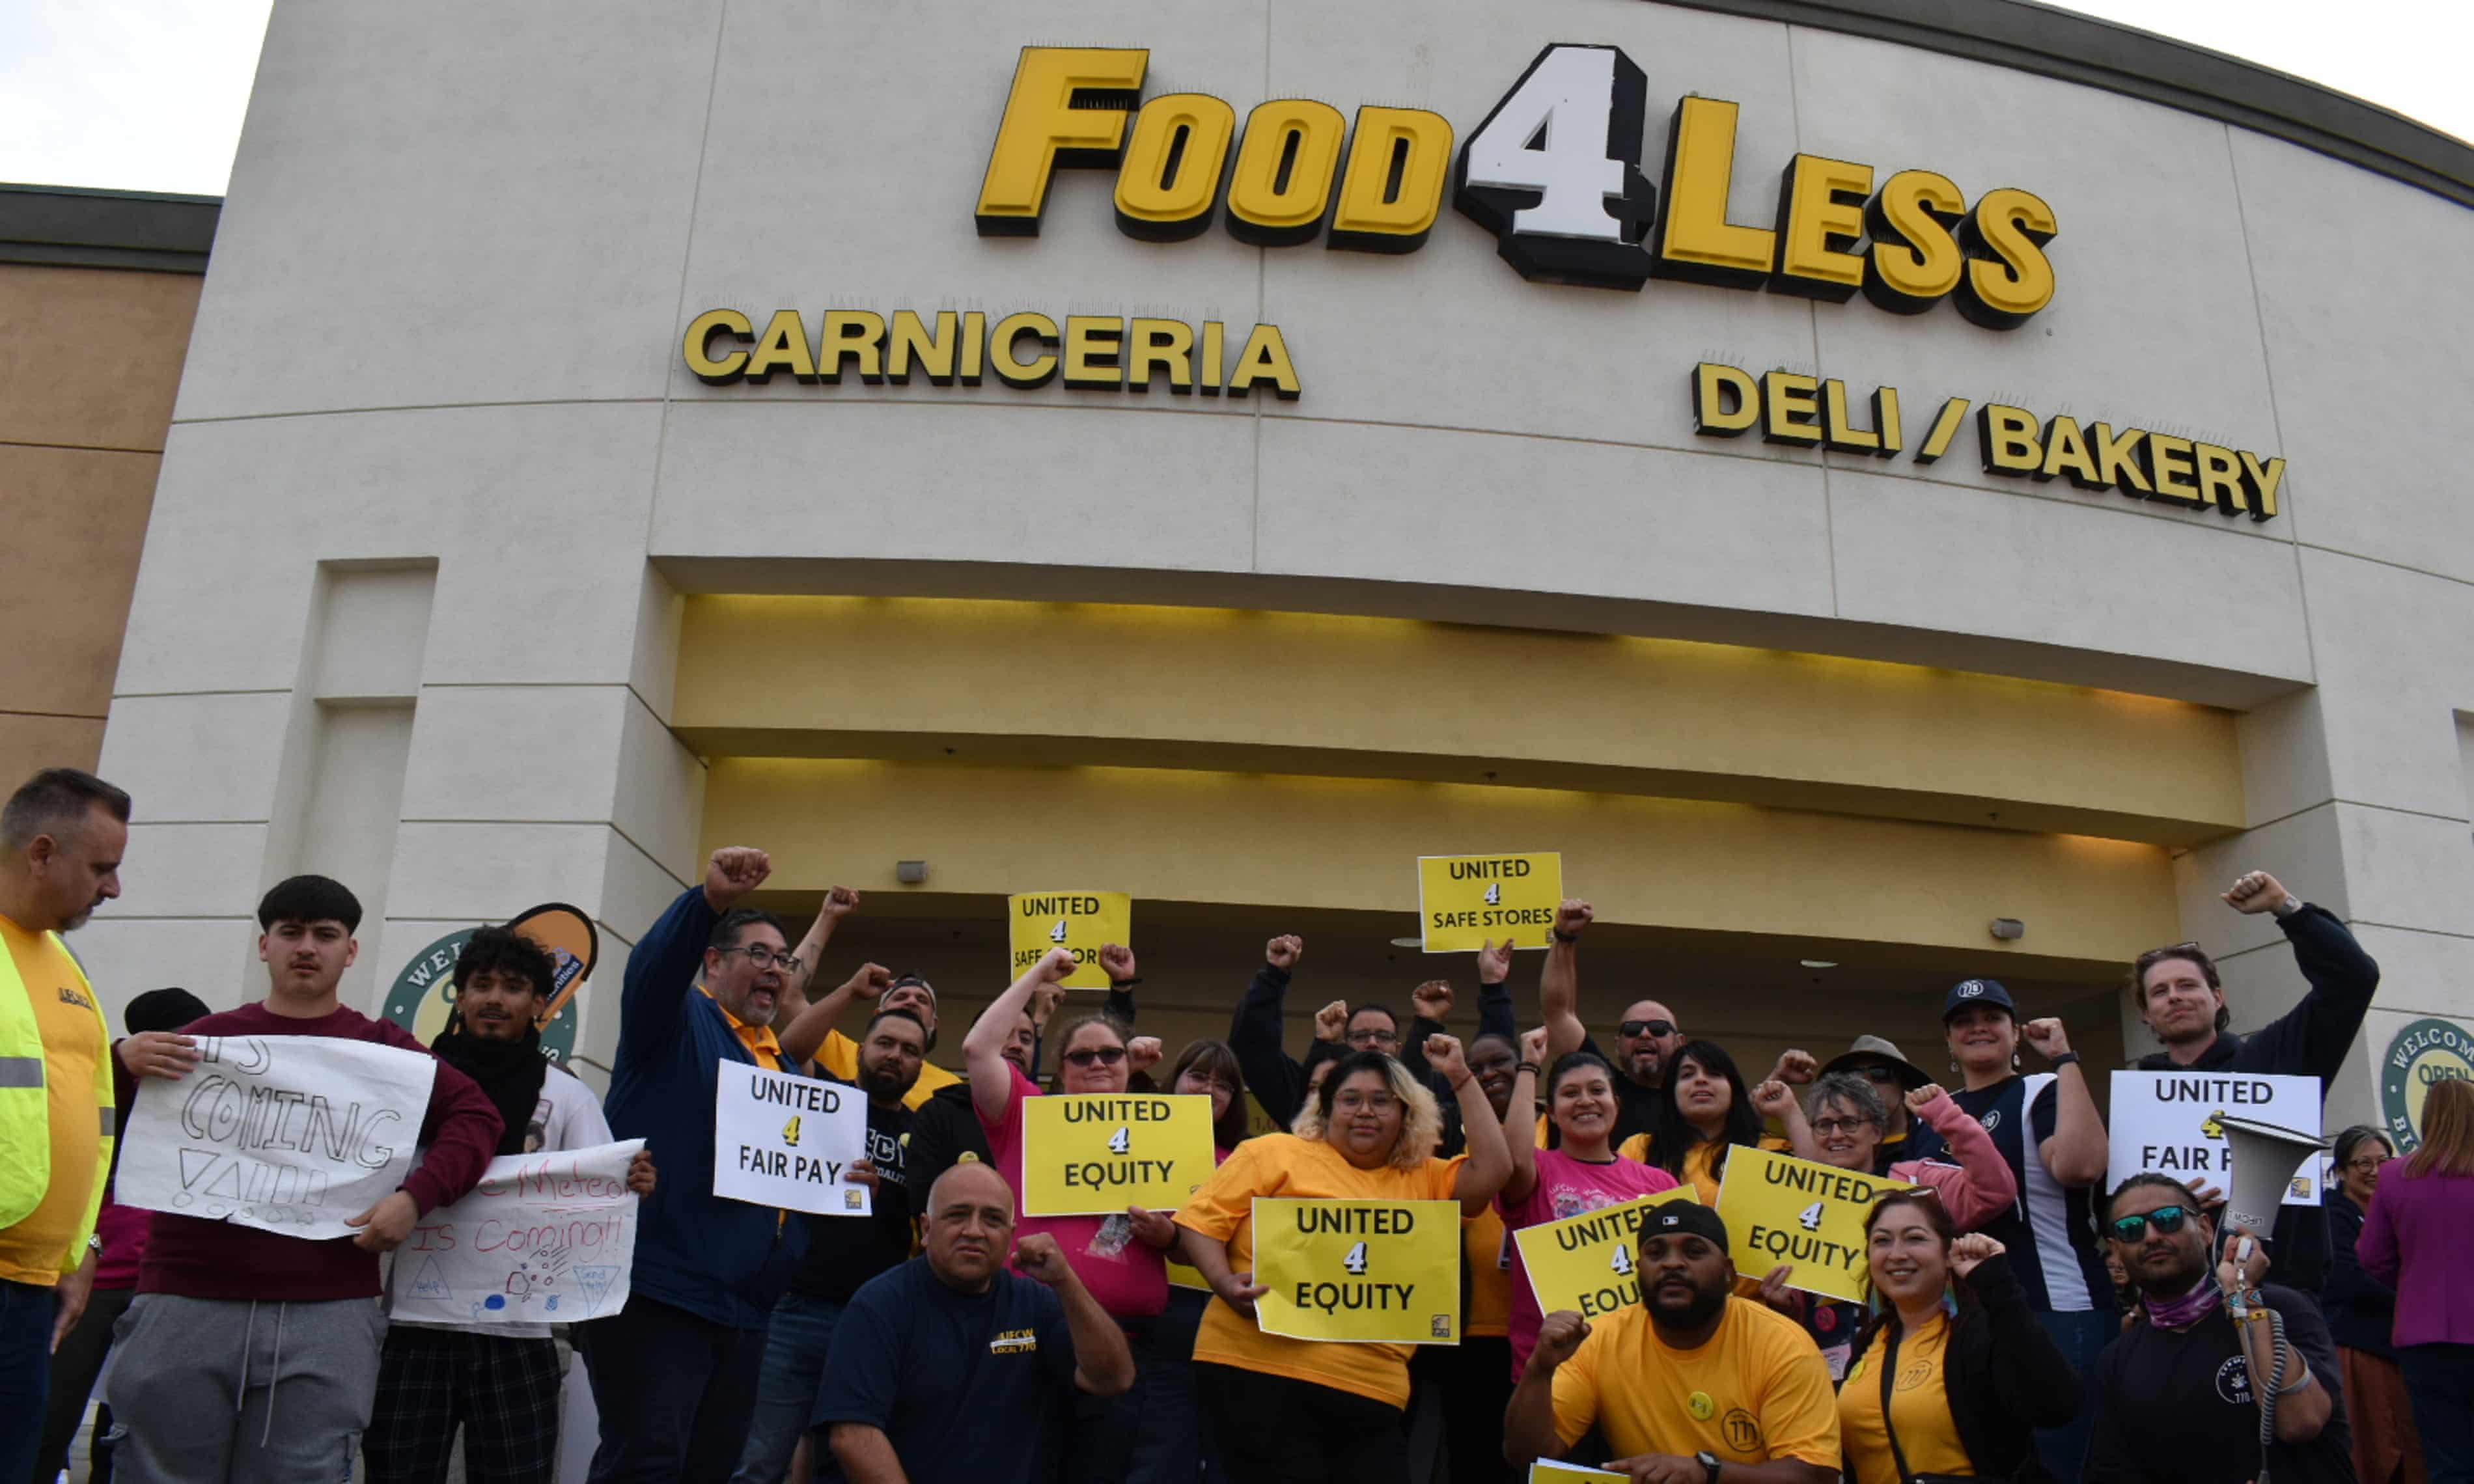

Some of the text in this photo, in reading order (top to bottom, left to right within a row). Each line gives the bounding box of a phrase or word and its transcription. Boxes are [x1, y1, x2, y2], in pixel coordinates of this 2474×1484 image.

[975, 42, 2059, 329] FOOD 4 LESS
[682, 308, 1301, 400] CARNICERIA
[1693, 362, 1903, 458] DELI
[1977, 404, 2286, 521] BAKERY
[1449, 859, 1531, 879] UNITED
[1022, 897, 1100, 917] UNITED
[1484, 883, 1501, 906] 4
[1049, 920, 1067, 943] 4
[1434, 908, 1553, 929] SAFE STORES
[1014, 948, 1042, 967] SAFE
[2393, 1028, 2474, 1069] WELCOM
[751, 1074, 841, 1114] UNITED
[2155, 1079, 2273, 1105] UNITED
[181, 1074, 401, 1169] COMING
[1064, 1100, 1171, 1123] UNITED
[782, 1114, 801, 1147] 4
[1107, 1126, 1130, 1155] 4
[740, 1145, 843, 1186] FAIR PAY
[2141, 1145, 2210, 1171] FAIR
[518, 1159, 632, 1200] Meteo
[1064, 1161, 1174, 1191] EQUITY
[1764, 1160, 1874, 1204] UNITED
[1296, 1207, 1415, 1235] UNITED
[1798, 1201, 1825, 1232] 4
[1343, 1241, 1368, 1276] 4
[1610, 1244, 1633, 1276] 4
[1748, 1224, 1860, 1271] EQUITY
[1296, 1282, 1415, 1315] EQUITY
